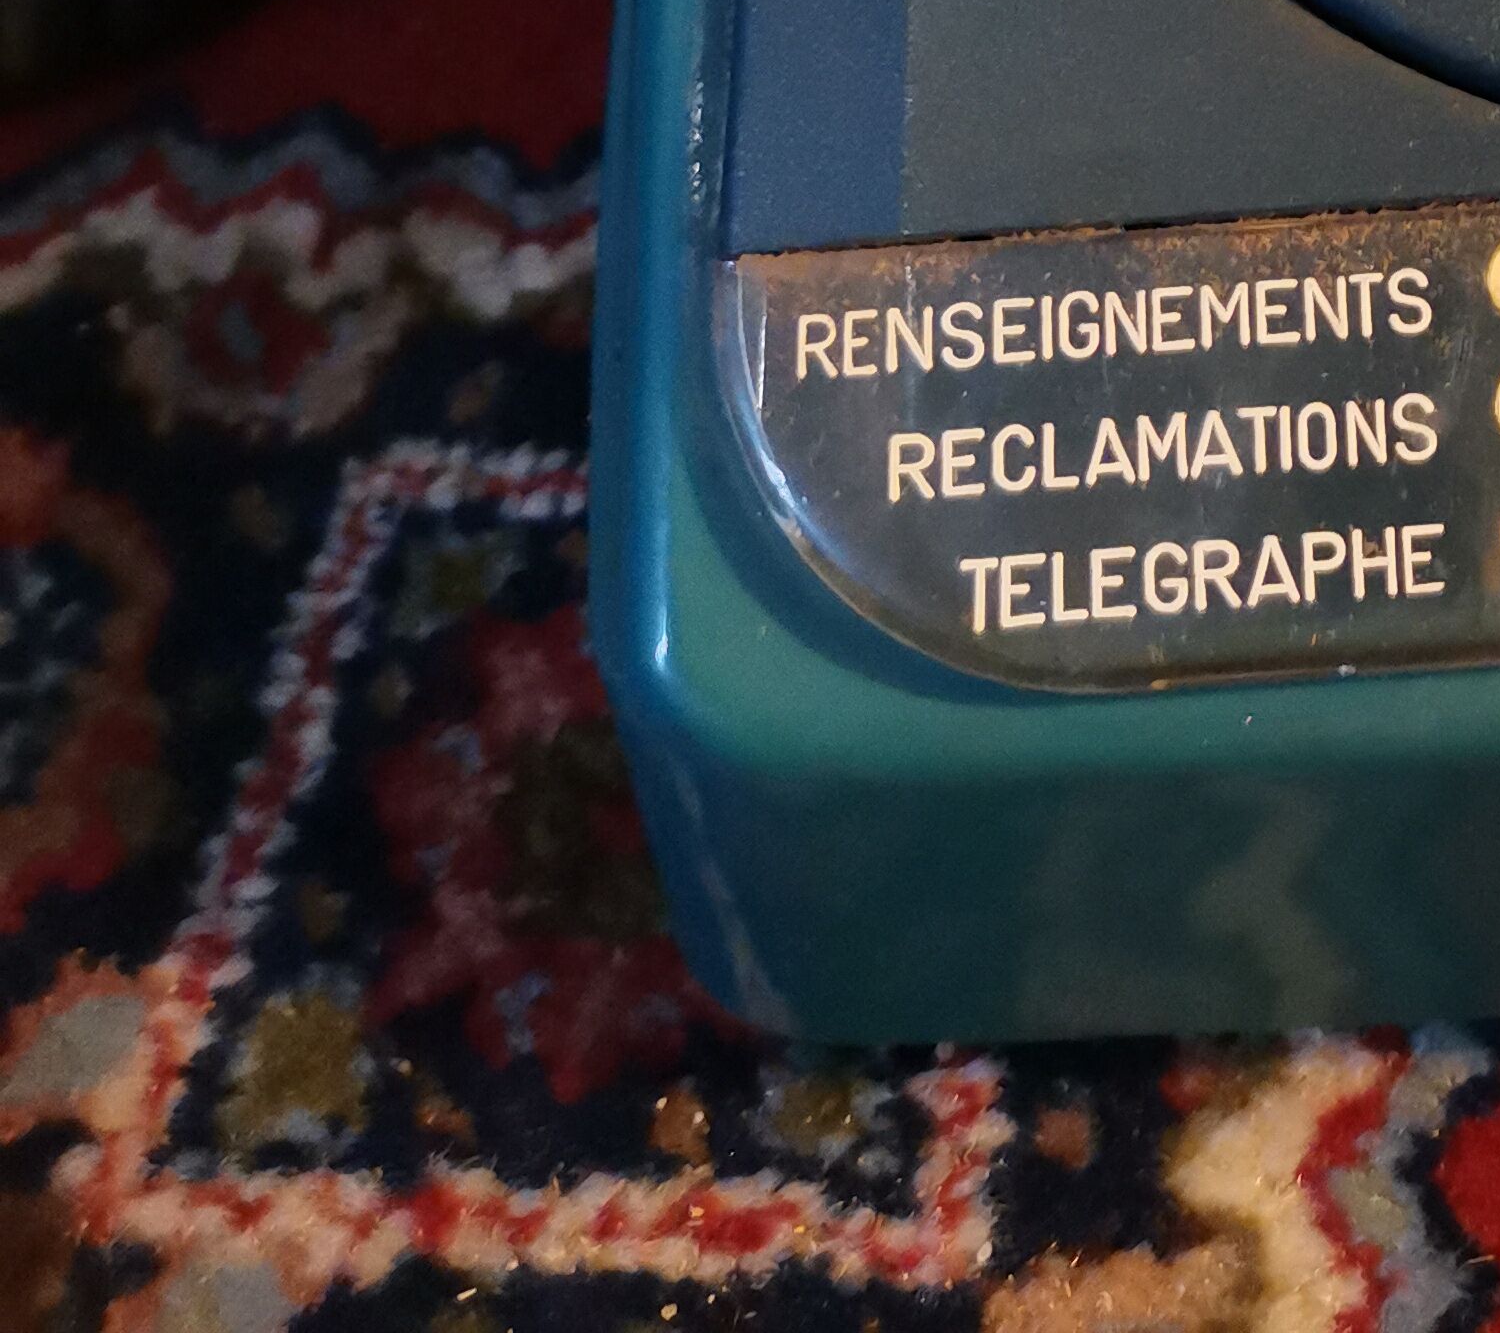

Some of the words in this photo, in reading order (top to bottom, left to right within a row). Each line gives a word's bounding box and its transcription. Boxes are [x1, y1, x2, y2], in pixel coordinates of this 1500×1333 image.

[797, 268, 1433, 380] RENSEIGNEMENTS
[888, 393, 1438, 503] RECLAMATIONS
[960, 523, 1446, 633] TELEGRAPHE
